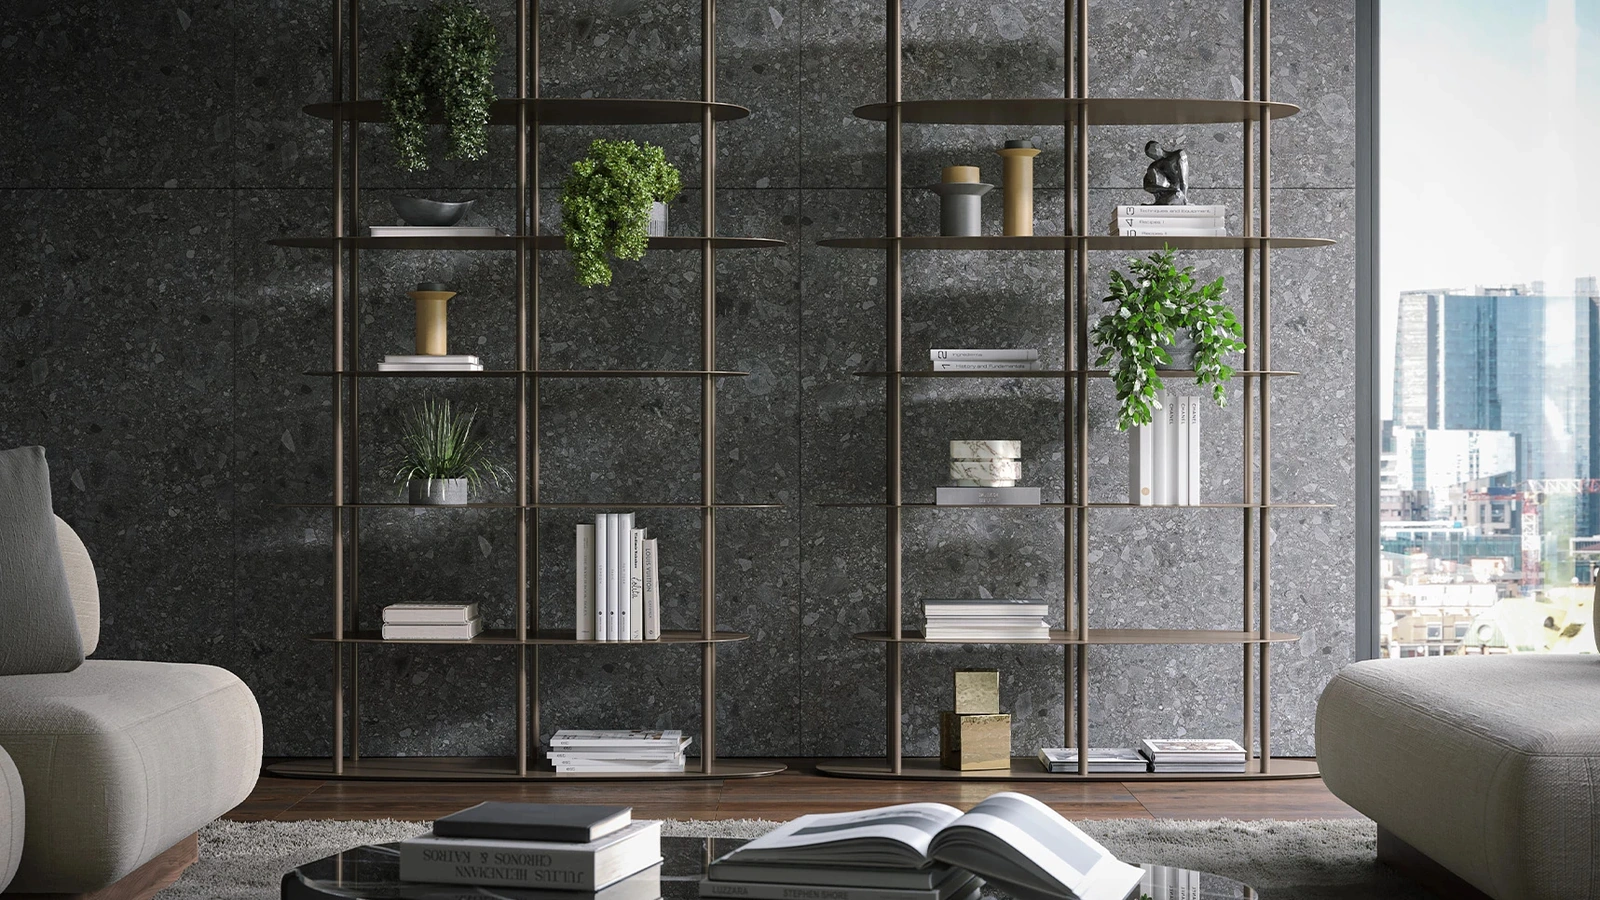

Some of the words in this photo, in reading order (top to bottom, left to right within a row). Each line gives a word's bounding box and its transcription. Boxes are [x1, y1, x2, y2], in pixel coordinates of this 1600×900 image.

[1126, 207, 1135, 216] 3
[1125, 218, 1133, 227] 4
[937, 350, 948, 360] 2
[423, 849, 471, 863] KAIROS
[480, 851, 489, 864] &
[494, 852, 552, 868] CHRONOS
[455, 866, 528, 882] HEINEMANN
[535, 869, 584, 884] JULIUS
[712, 885, 748, 895] LUZZARA
[783, 888, 819, 899] STEPHEN
[821, 890, 849, 900] SHORE
